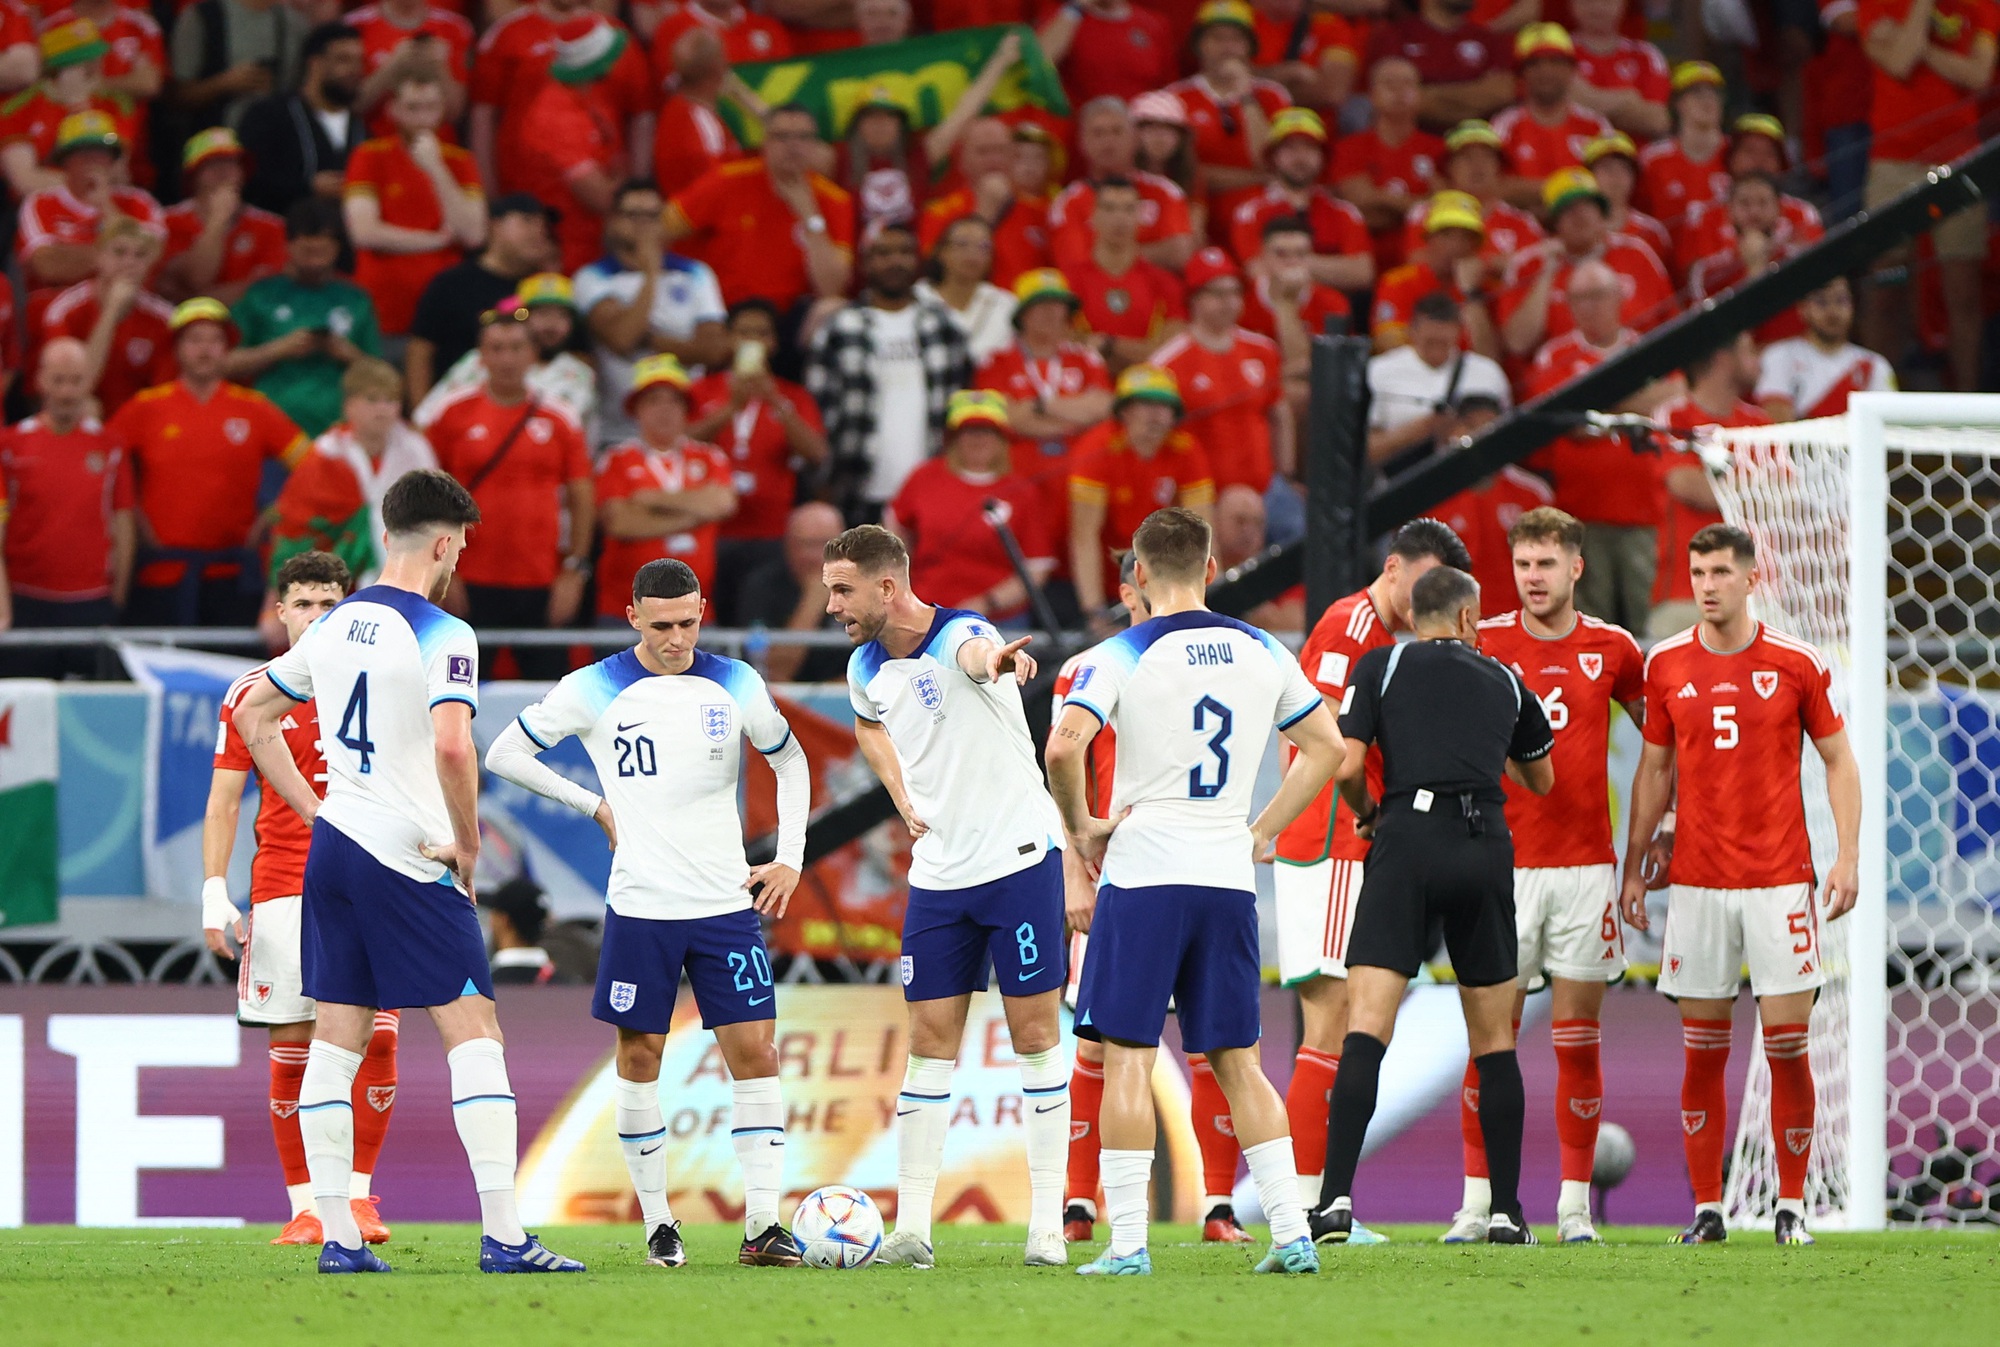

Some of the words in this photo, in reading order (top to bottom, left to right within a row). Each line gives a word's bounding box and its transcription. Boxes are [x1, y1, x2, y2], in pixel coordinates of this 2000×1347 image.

[1186, 643, 1234, 665] SHAW
[336, 671, 375, 774] 4
[1543, 687, 1569, 730] 6
[1713, 705, 1740, 749] 5
[614, 735, 657, 777] 20
[1189, 694, 1232, 798] 3
[1016, 922, 1039, 965] 8
[1601, 902, 1617, 941] 6
[1787, 911, 1812, 954] 5
[728, 946, 772, 991] 20
[685, 1017, 1013, 1085] ARLIE
[0, 1015, 245, 1227] E
[670, 1105, 733, 1140] OF
[784, 1100, 848, 1133] HE
[876, 1095, 1024, 1131] YAR
